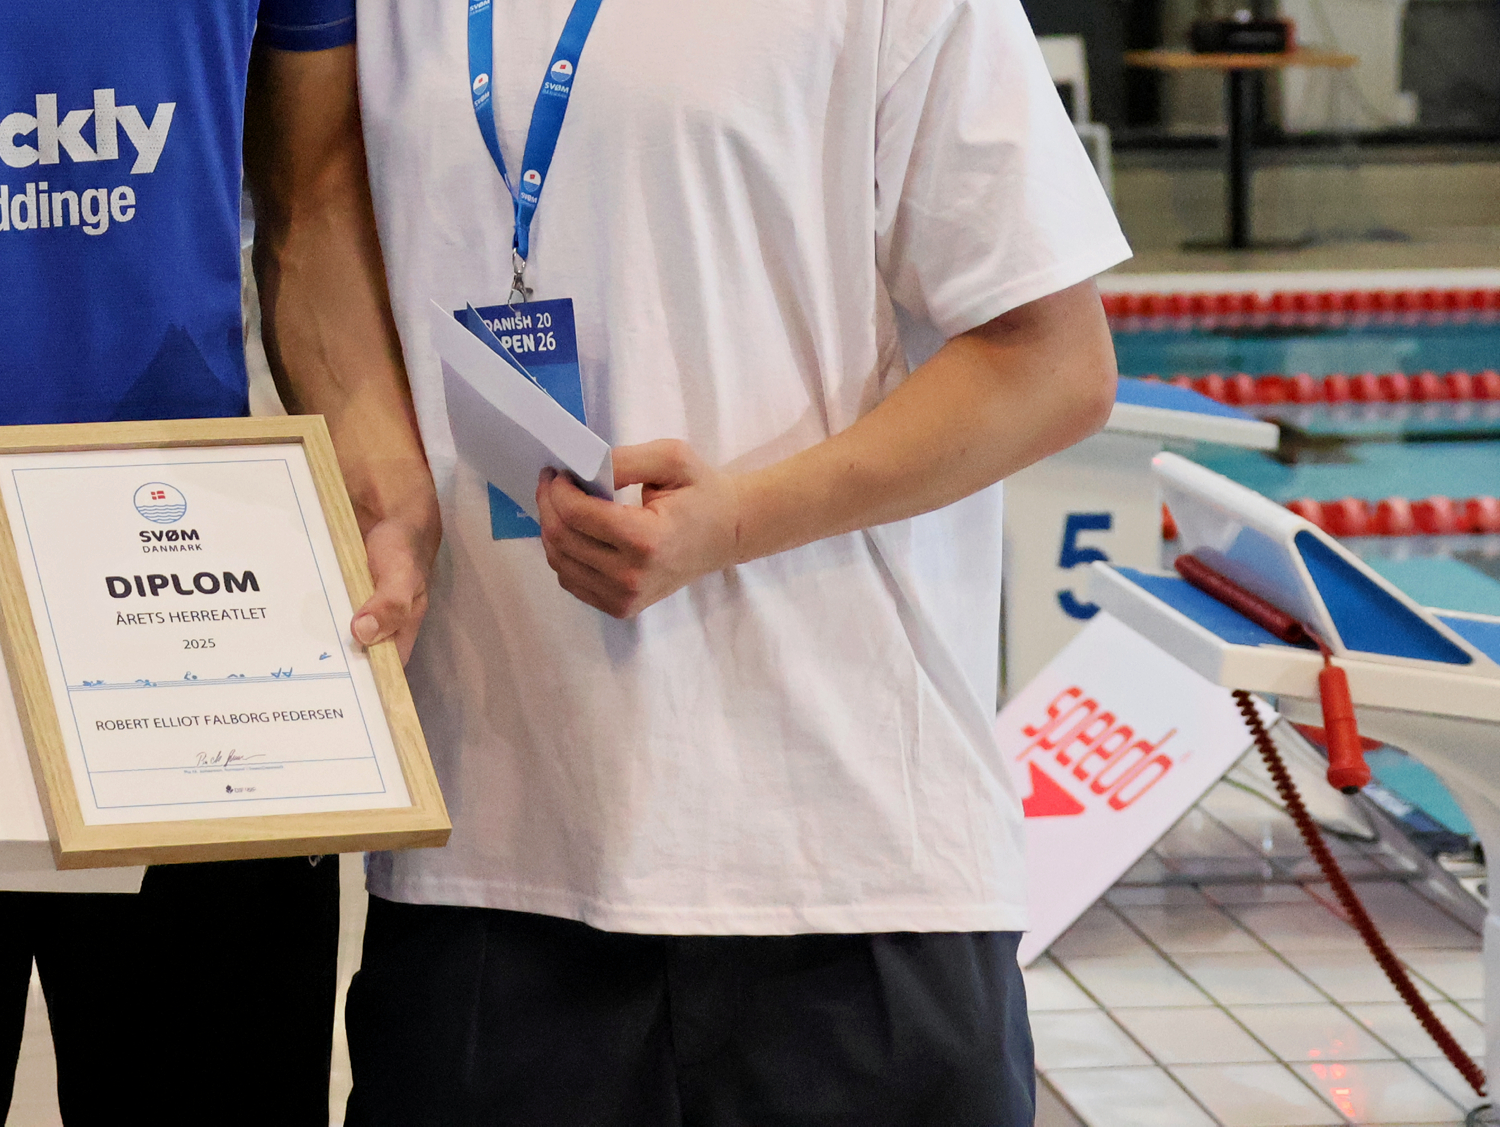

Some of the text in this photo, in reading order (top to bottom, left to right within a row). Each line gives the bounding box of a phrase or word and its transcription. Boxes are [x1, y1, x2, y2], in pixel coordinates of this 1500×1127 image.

[483, 312, 552, 332] DANISH 20
[500, 331, 557, 353] PEN 26
[138, 528, 201, 543] SVØM
[142, 543, 204, 554] DANMARK
[1057, 511, 1113, 620] 5
[105, 570, 261, 599] DIPLOM
[115, 607, 268, 626] ÅRETS HERREATLET
[182, 637, 217, 651] 2025
[95, 708, 345, 731] ROBERT ELLIOT FALBORG PEDERSEN
[1015, 685, 1177, 811] speedo
